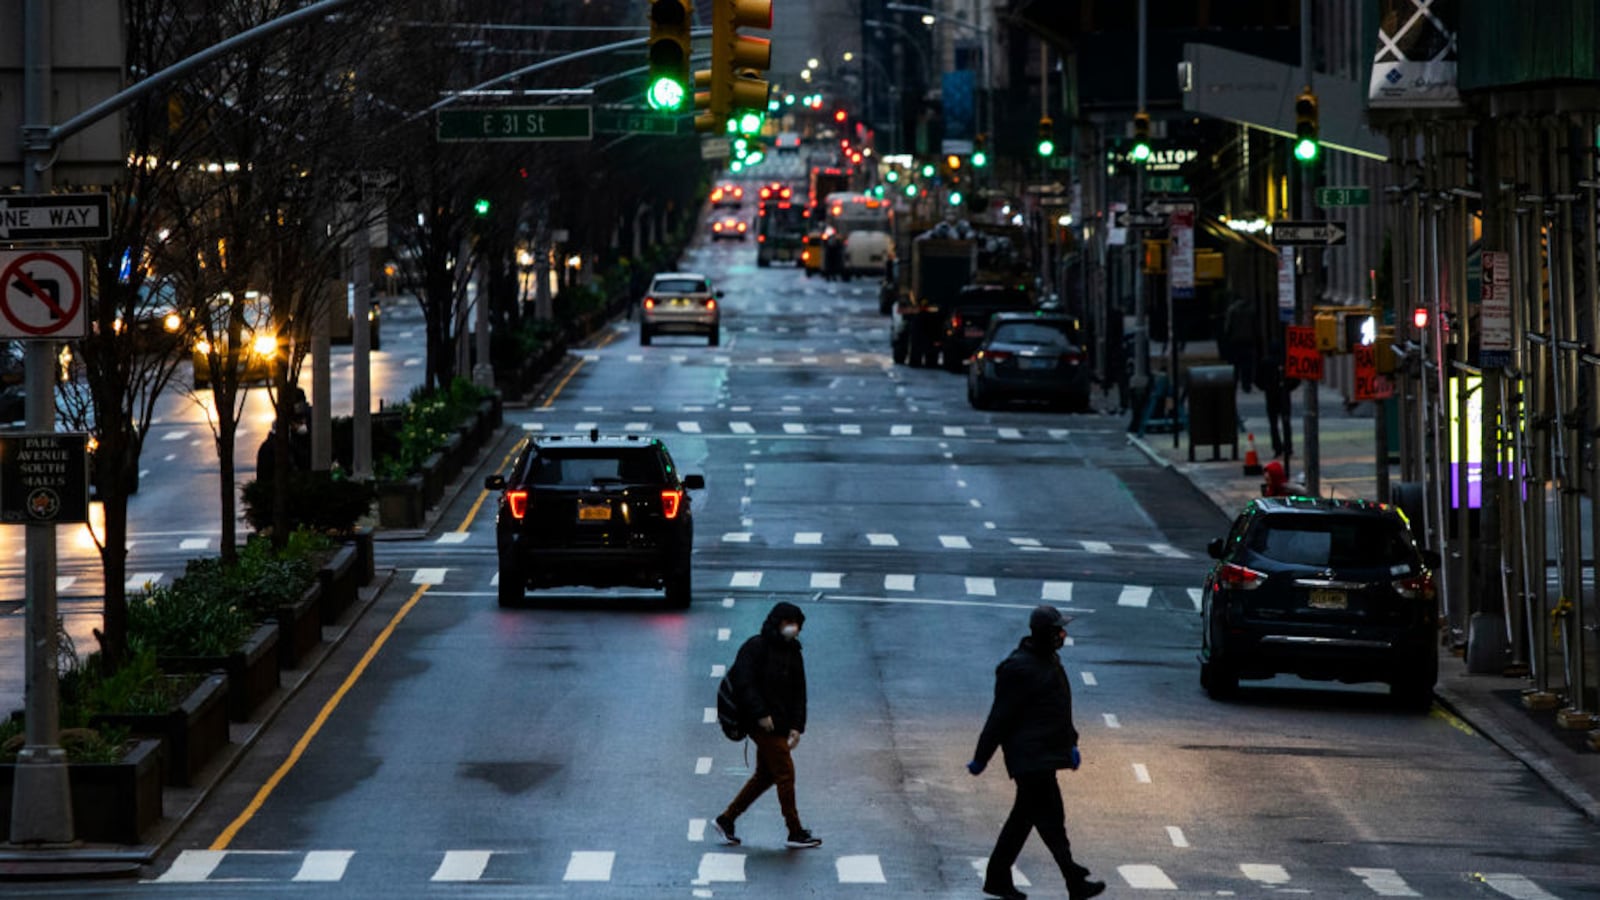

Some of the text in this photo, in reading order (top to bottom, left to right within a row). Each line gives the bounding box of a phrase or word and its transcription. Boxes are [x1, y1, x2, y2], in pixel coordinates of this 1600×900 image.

[483, 113, 545, 133] E 31 St
[1137, 149, 1198, 163] ALTON
[1322, 190, 1330, 204] E
[1336, 190, 1350, 204] 31
[0, 207, 90, 227] NE WAY
[1279, 227, 1336, 239] ONE WAY
[1288, 331, 1316, 349] RAIS
[1288, 355, 1320, 374] PLOW
[25, 438, 59, 448] PARK
[17, 450, 69, 460] AVENUE
[20, 463, 66, 473] SOUTH
